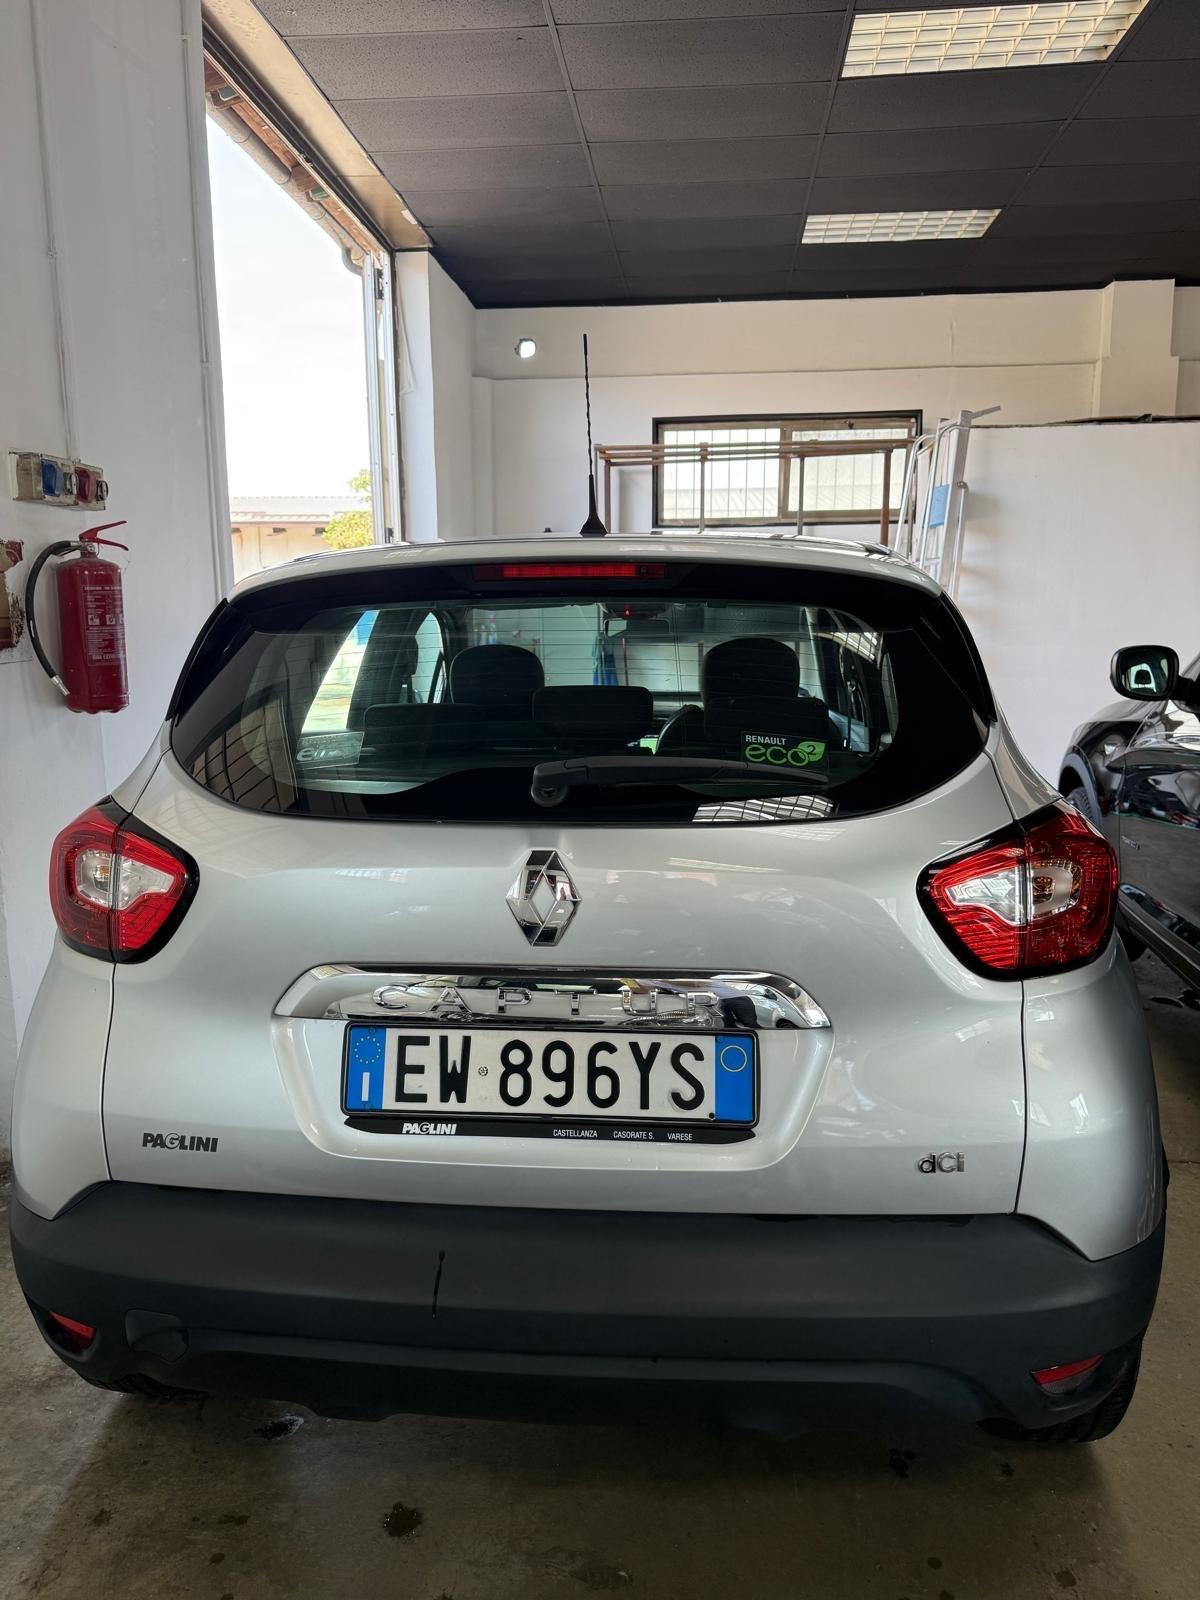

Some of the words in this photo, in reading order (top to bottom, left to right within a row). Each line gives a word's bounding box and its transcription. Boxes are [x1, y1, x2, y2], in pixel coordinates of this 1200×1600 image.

[745, 734, 786, 746] RENAULT
[372, 984, 725, 1017] CAPTUR
[395, 1035, 472, 1103] EW
[499, 1039, 705, 1111] 896YS
[402, 1122, 457, 1135] PAGLINI
[553, 1129, 598, 1138] CASTELLANZA
[613, 1130, 647, 1139] CASORATE
[648, 1131, 655, 1140] S.
[667, 1132, 693, 1141] VARESE
[142, 1132, 218, 1153] PAGLINI
[918, 1151, 964, 1173] dCi
